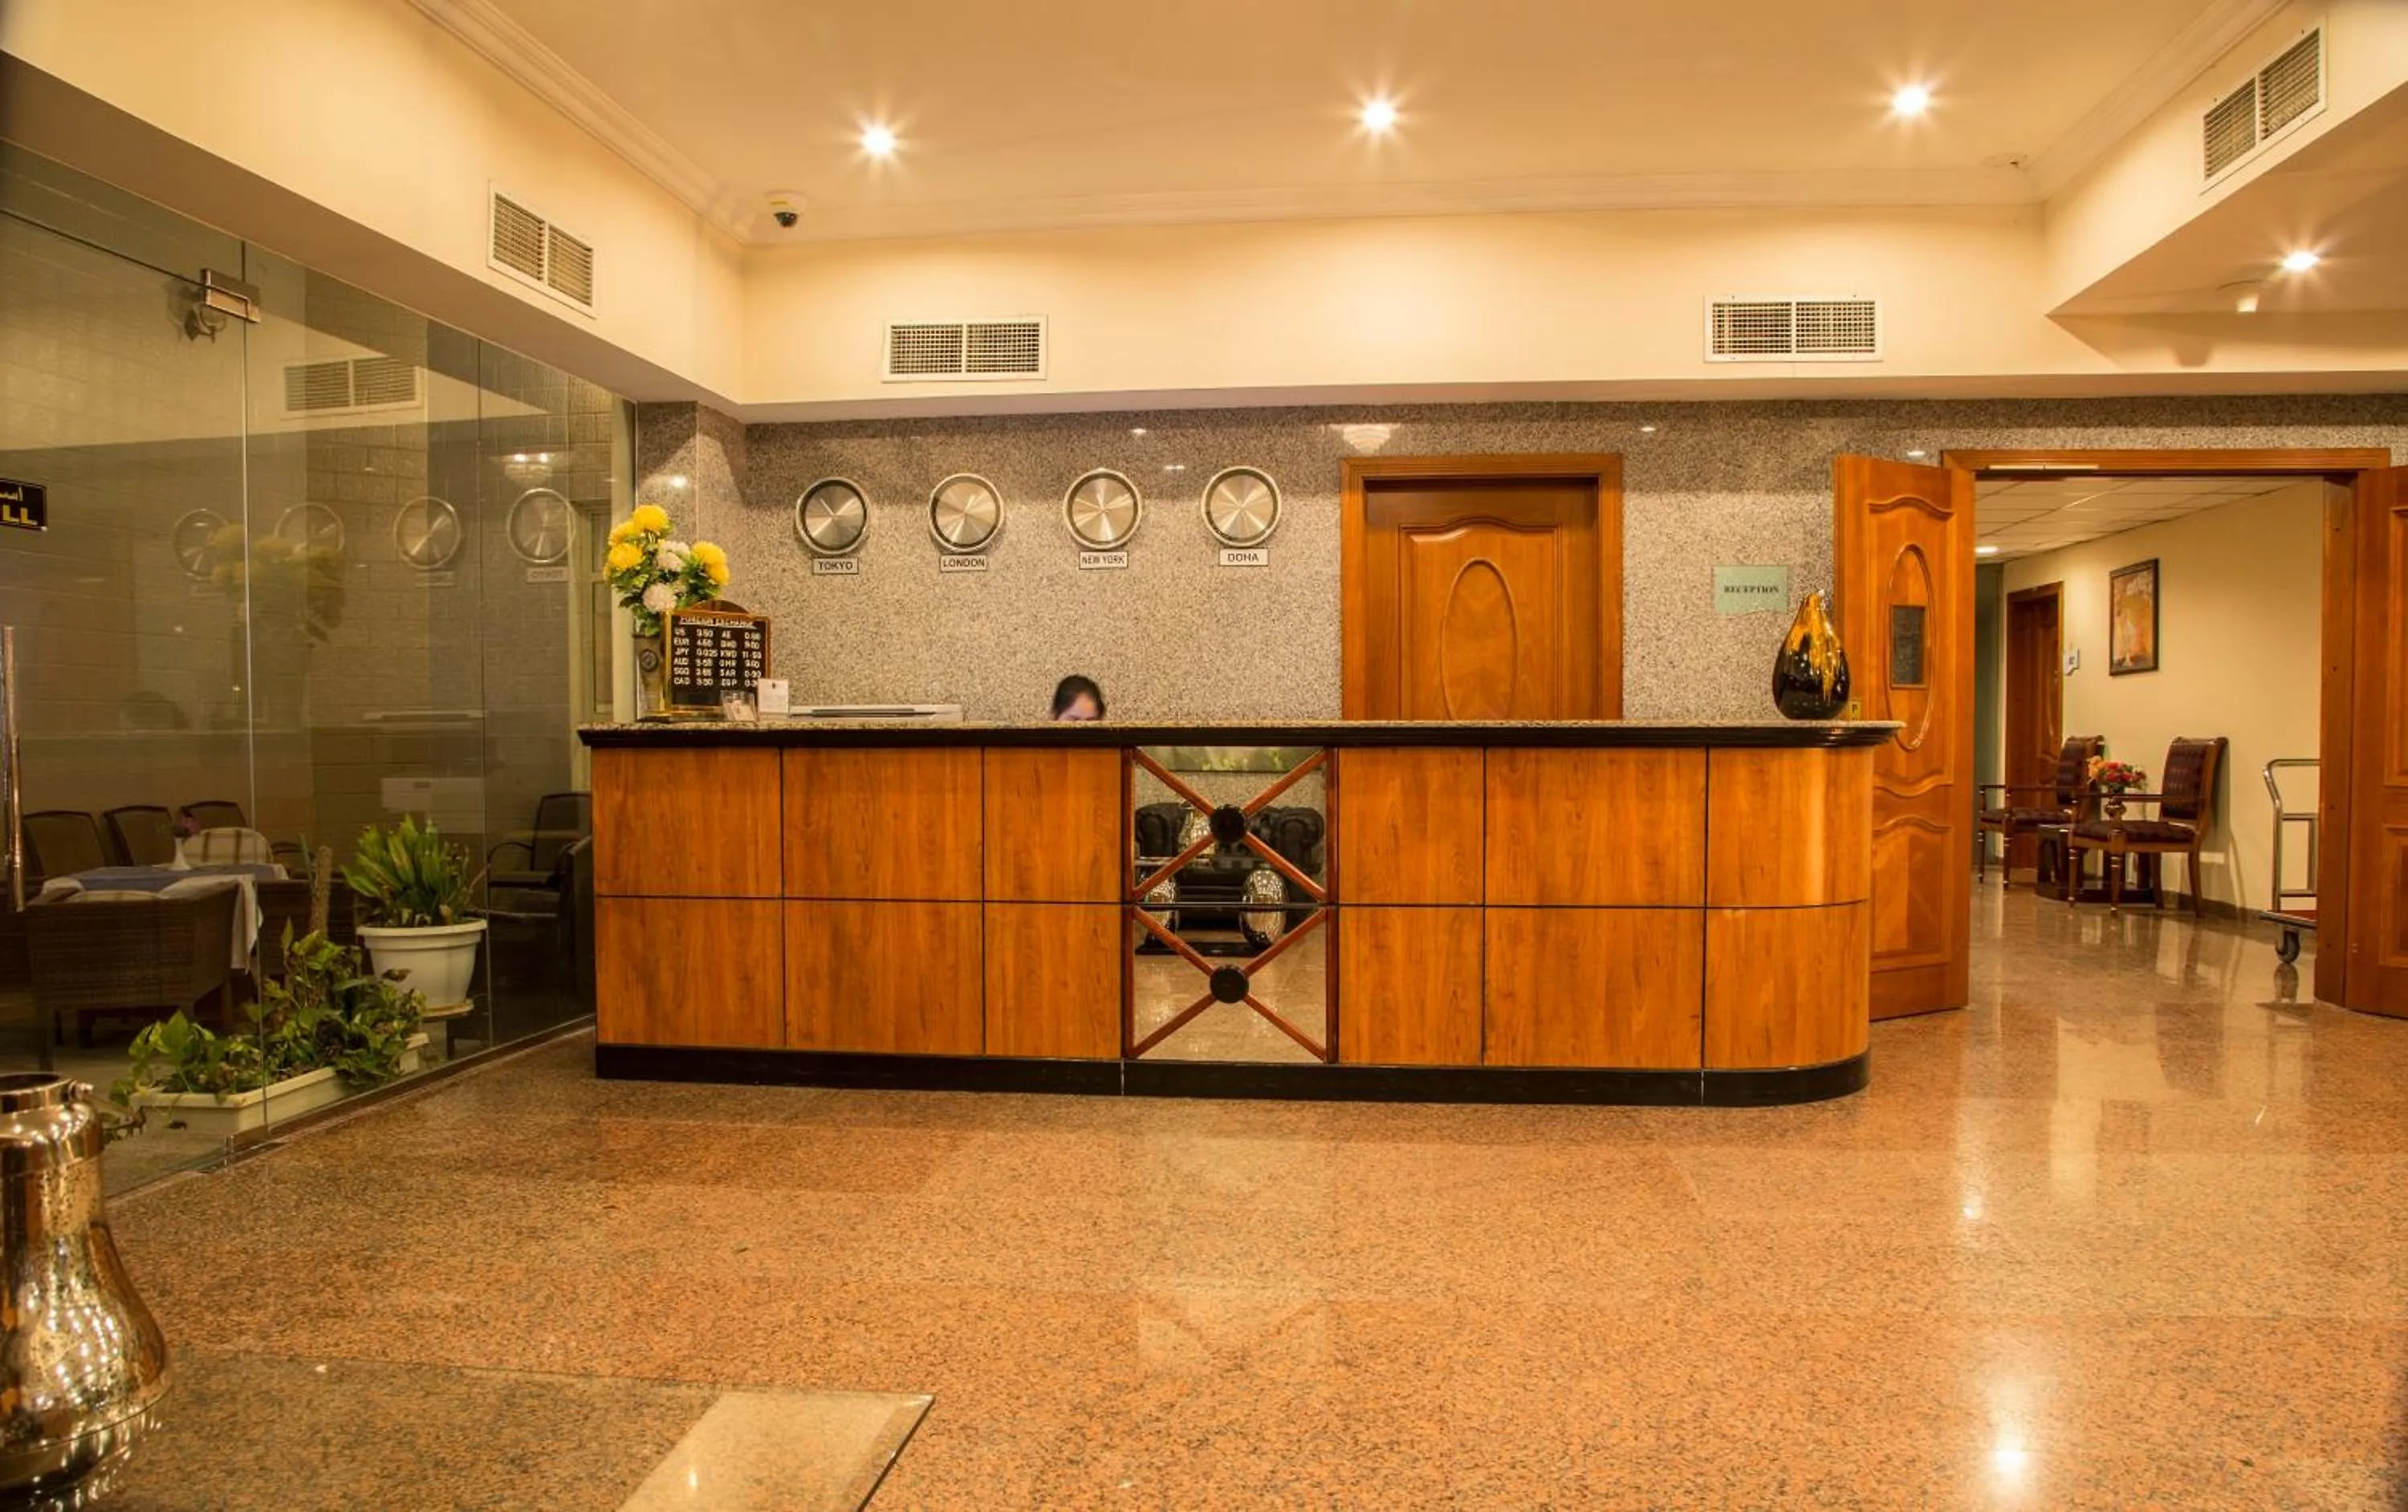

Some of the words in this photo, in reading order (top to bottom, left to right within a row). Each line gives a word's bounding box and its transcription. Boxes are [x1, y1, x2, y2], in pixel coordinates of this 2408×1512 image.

[2, 505, 38, 526] LL
[1081, 555, 1100, 564] NEW
[1102, 555, 1125, 564] YORK
[1227, 553, 1259, 562] DOHA
[818, 561, 853, 571] TOKYO
[942, 558, 985, 567] LONDON
[1723, 585, 1779, 593] RECEPTION
[675, 647, 689, 655] JPY
[719, 669, 736, 677] SAR
[673, 677, 690, 685] CAD
